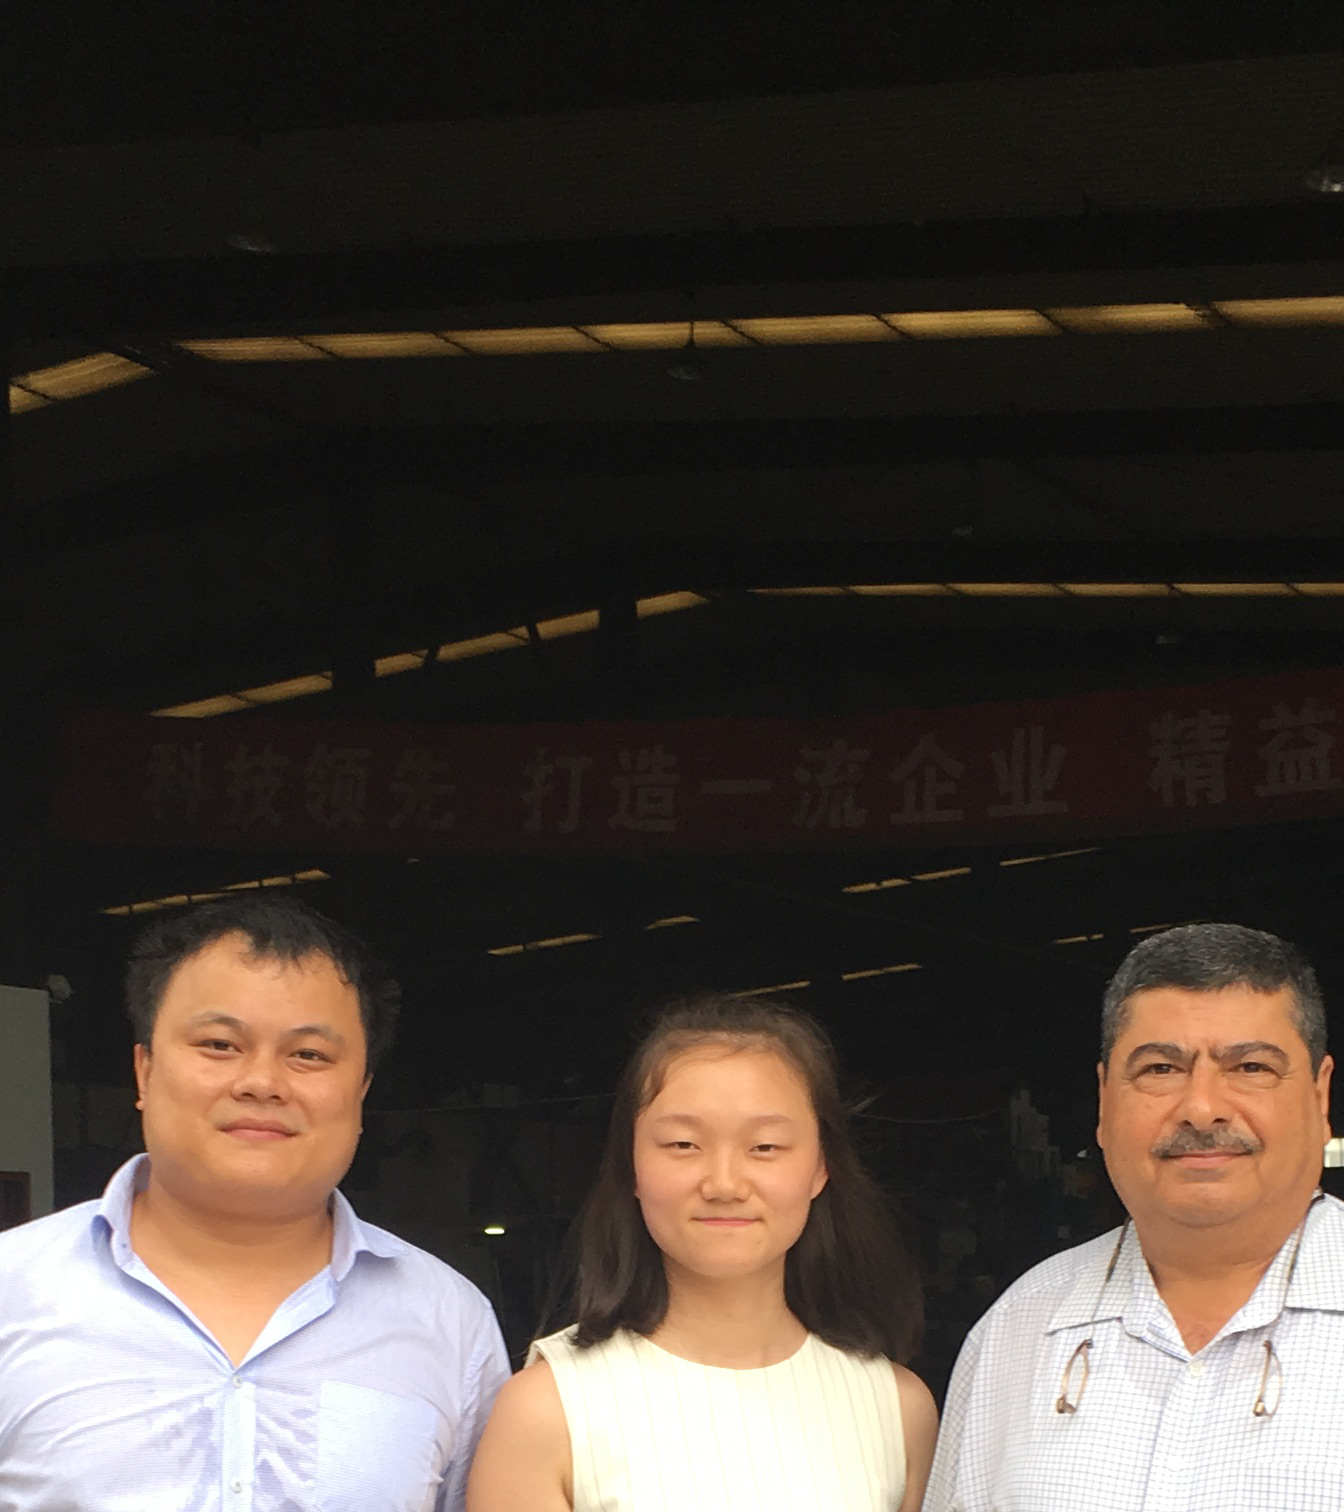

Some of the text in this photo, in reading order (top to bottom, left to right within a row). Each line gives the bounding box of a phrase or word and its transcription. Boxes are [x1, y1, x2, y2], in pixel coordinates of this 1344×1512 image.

[521, 724, 1069, 834] 打造一流企业
